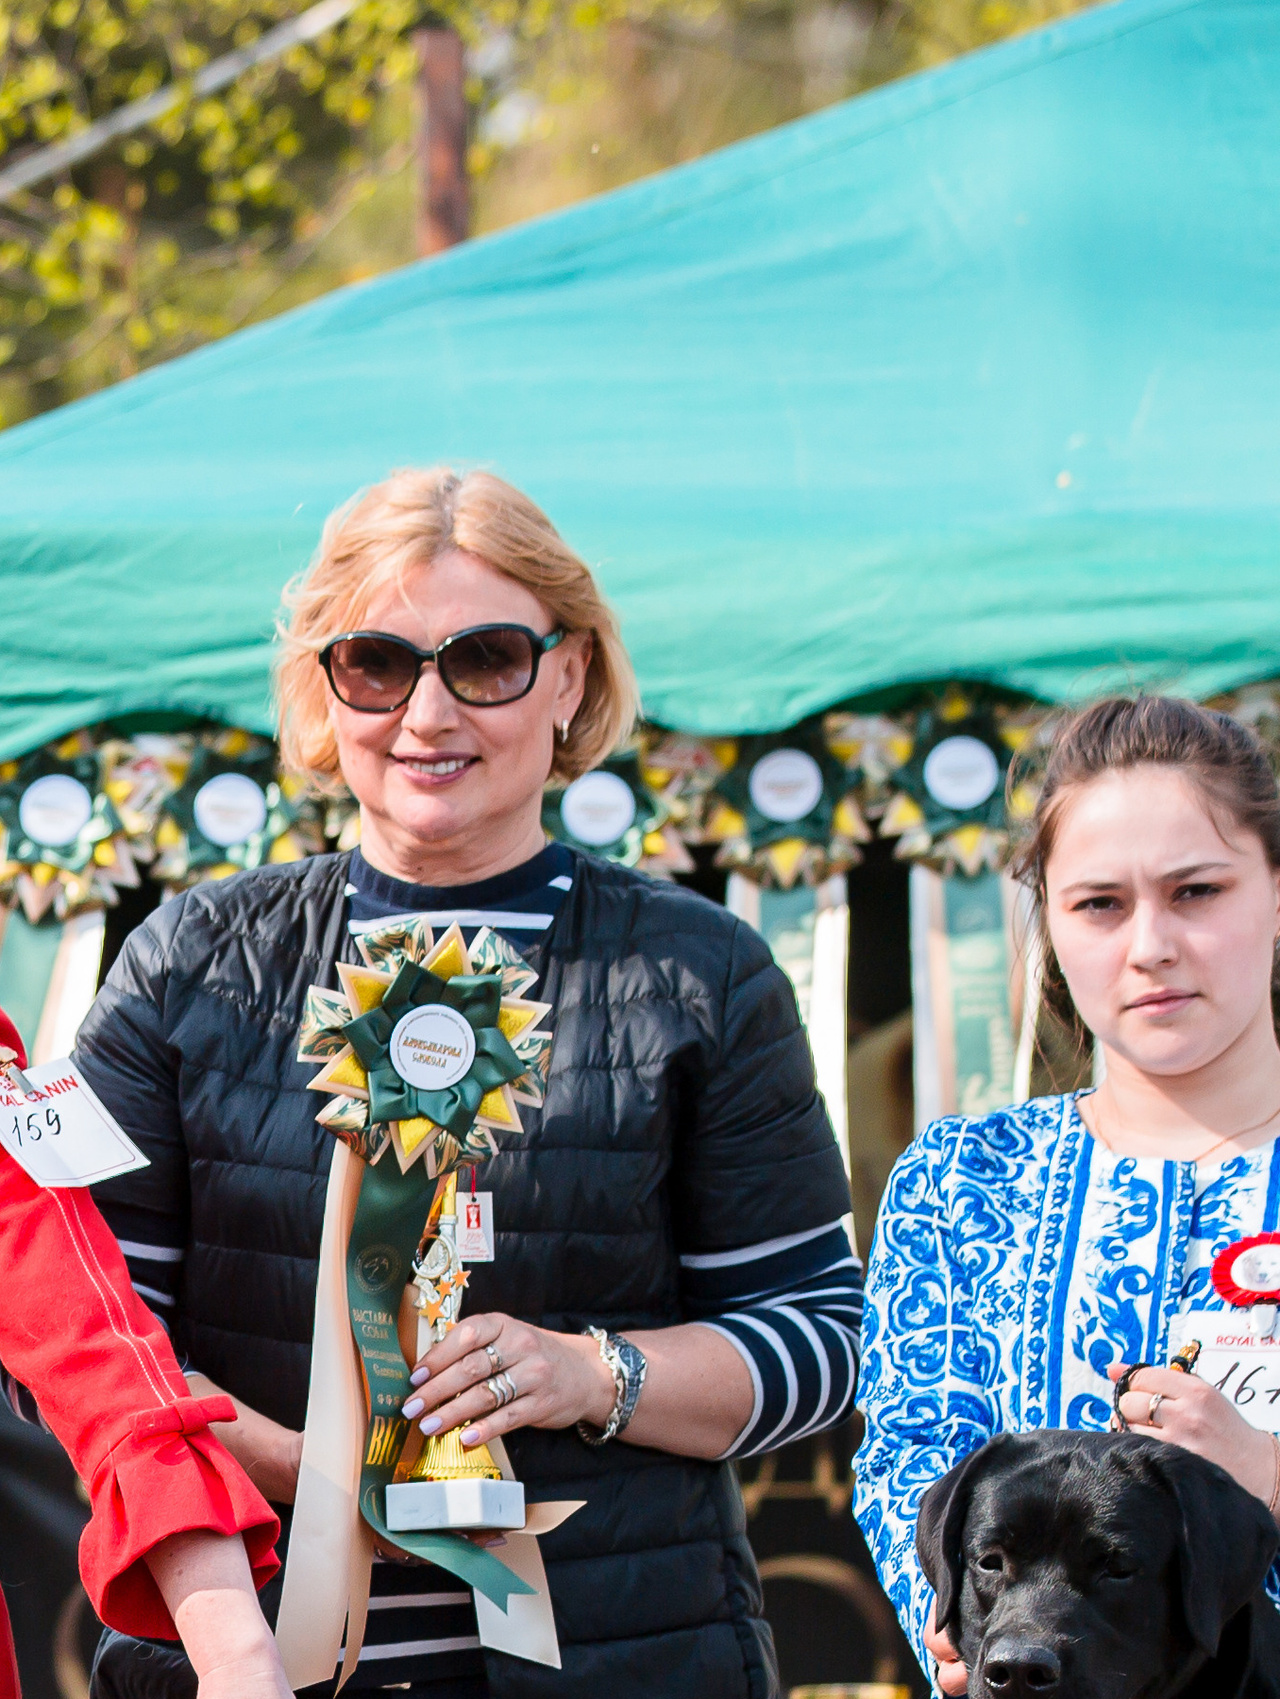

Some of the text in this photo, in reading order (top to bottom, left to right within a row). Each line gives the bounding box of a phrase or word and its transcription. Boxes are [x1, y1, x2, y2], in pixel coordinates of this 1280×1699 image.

[25, 1074, 79, 1102] CANIN
[12, 1108, 61, 1147] 159
[1216, 1335, 1256, 1347] ROYAL
